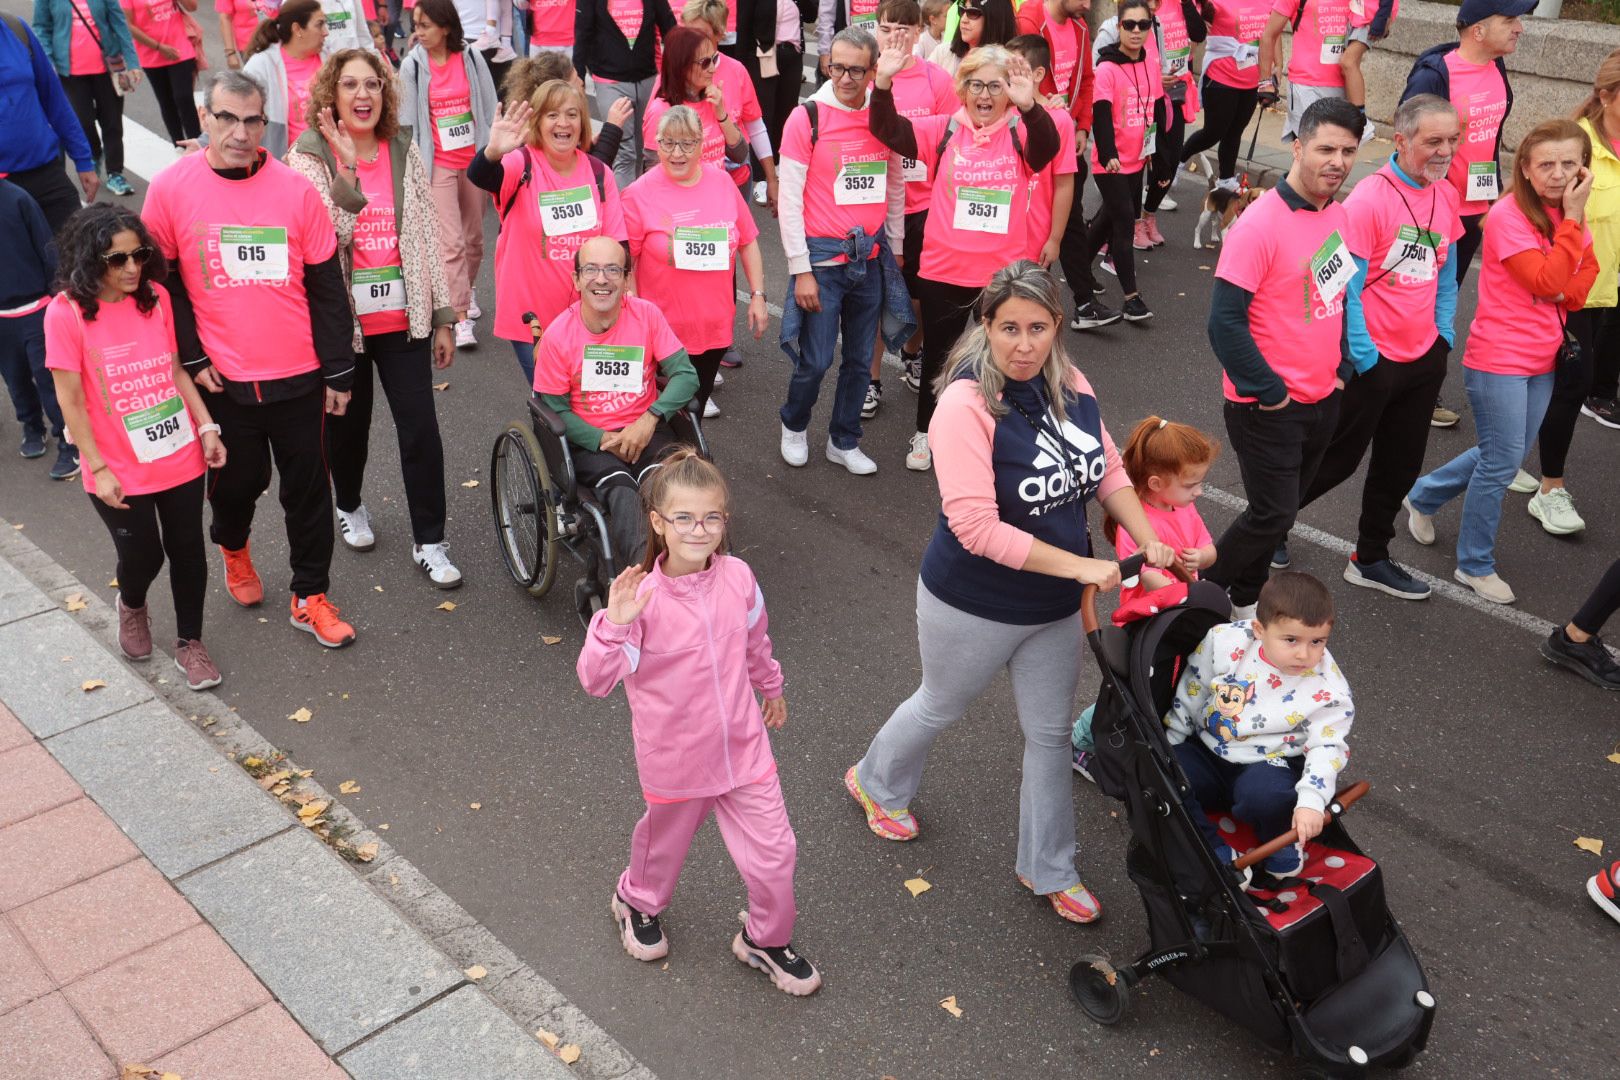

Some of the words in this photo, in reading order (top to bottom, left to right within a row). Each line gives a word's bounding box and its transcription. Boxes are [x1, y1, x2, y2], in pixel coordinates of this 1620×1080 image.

[624, 8, 643, 16] marc
[1330, 5, 1350, 13] marc
[1240, 29, 1263, 39] cánc
[1319, 23, 1346, 35] cánc
[445, 96, 470, 107] marc
[1469, 106, 1482, 116] En
[1483, 100, 1507, 113] marc
[897, 106, 930, 117] archa
[449, 124, 471, 138] 4038
[1467, 126, 1499, 143] cánc
[902, 157, 917, 169] 59
[973, 154, 1017, 169] marcha
[953, 169, 1002, 182] contra
[1004, 167, 1018, 180] el
[844, 176, 875, 190] 3532
[551, 203, 583, 220] 3530
[967, 202, 998, 219] 3531
[353, 232, 398, 251] cánc
[548, 234, 587, 247] contr
[237, 245, 266, 262] 615
[685, 241, 716, 256] 3529
[370, 282, 391, 299] 617
[104, 363, 127, 378] En
[595, 360, 630, 377] 3533
[110, 371, 167, 395] contra
[114, 385, 177, 413] cánce
[145, 416, 181, 443] 5264
[1018, 453, 1107, 503] adida
